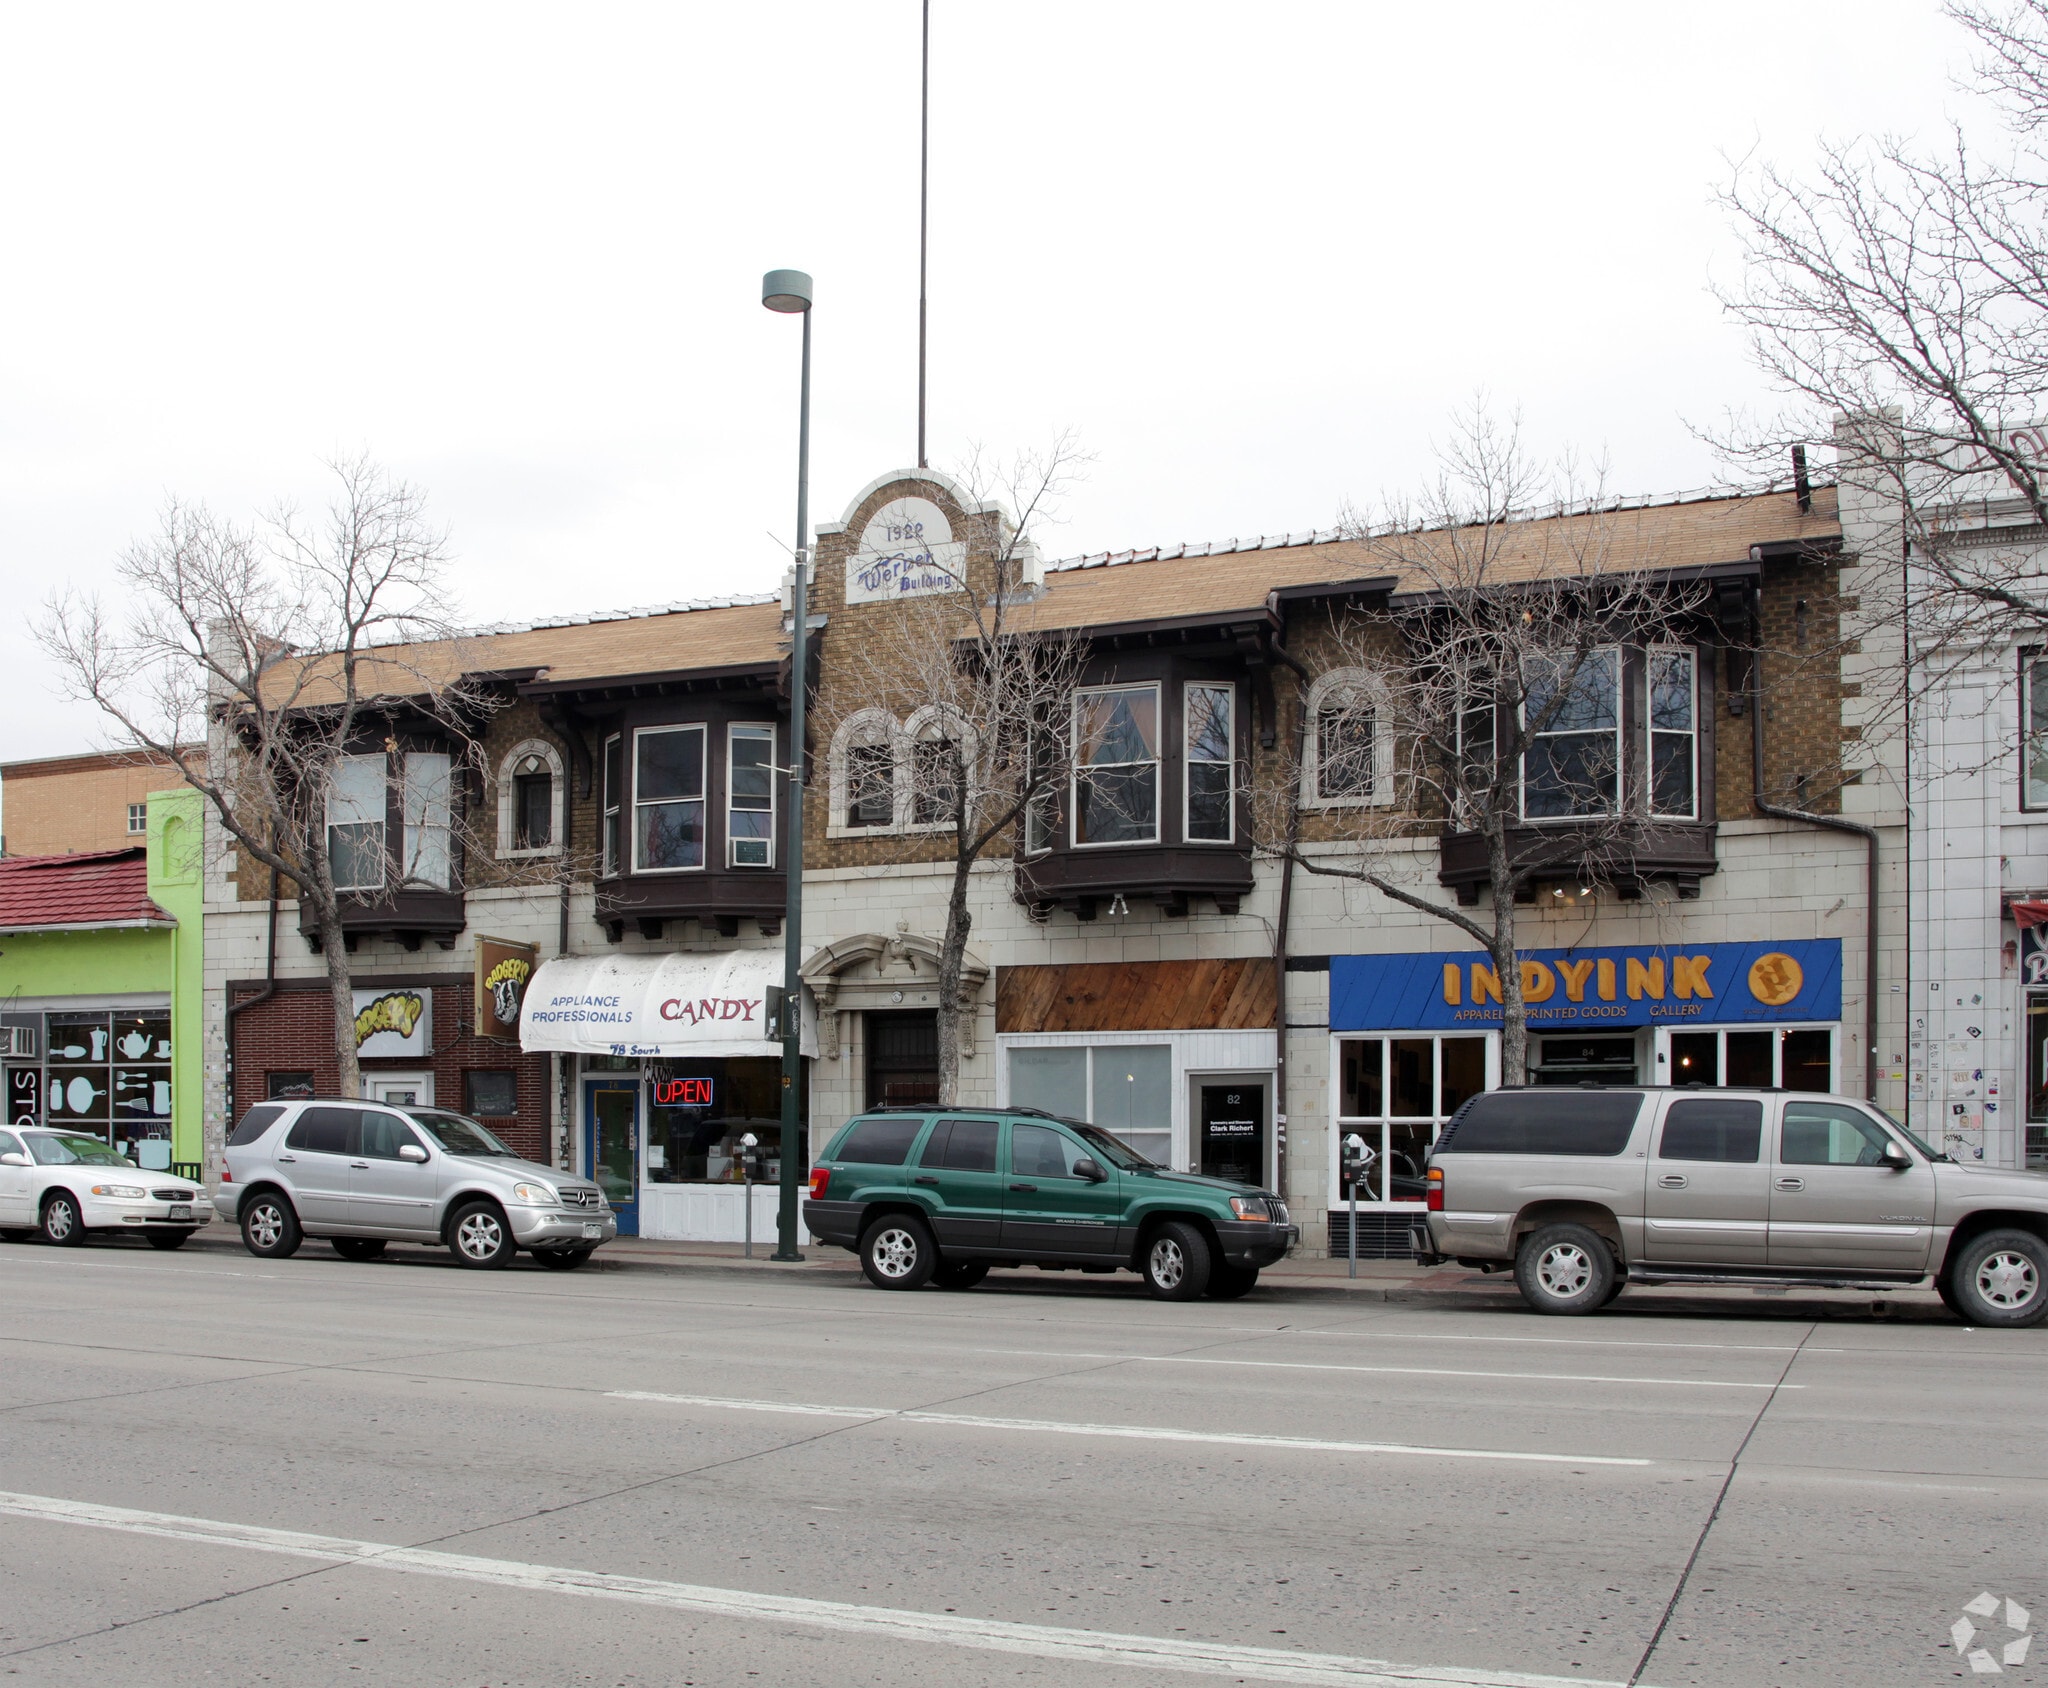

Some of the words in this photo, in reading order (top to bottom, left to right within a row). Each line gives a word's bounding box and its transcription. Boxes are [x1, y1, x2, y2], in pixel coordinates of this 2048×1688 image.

[901, 575, 951, 592] Building
[485, 958, 530, 990] BADGER'S
[1443, 955, 1714, 1005] INDYINK
[550, 996, 620, 1007] APPLIANCE
[532, 1011, 632, 1023] PROFESSIONALS
[660, 998, 762, 1026] CANDY
[1454, 1009, 1504, 1020] APPAREL
[1524, 1008, 1577, 1019] PRINTED
[1581, 1006, 1627, 1017] GOODS
[1650, 1004, 1704, 1017] GALLERY
[609, 1044, 626, 1056] 78
[1582, 1048, 1594, 1057] 84
[656, 1080, 711, 1103] OPEN
[1227, 1094, 1240, 1105] 82
